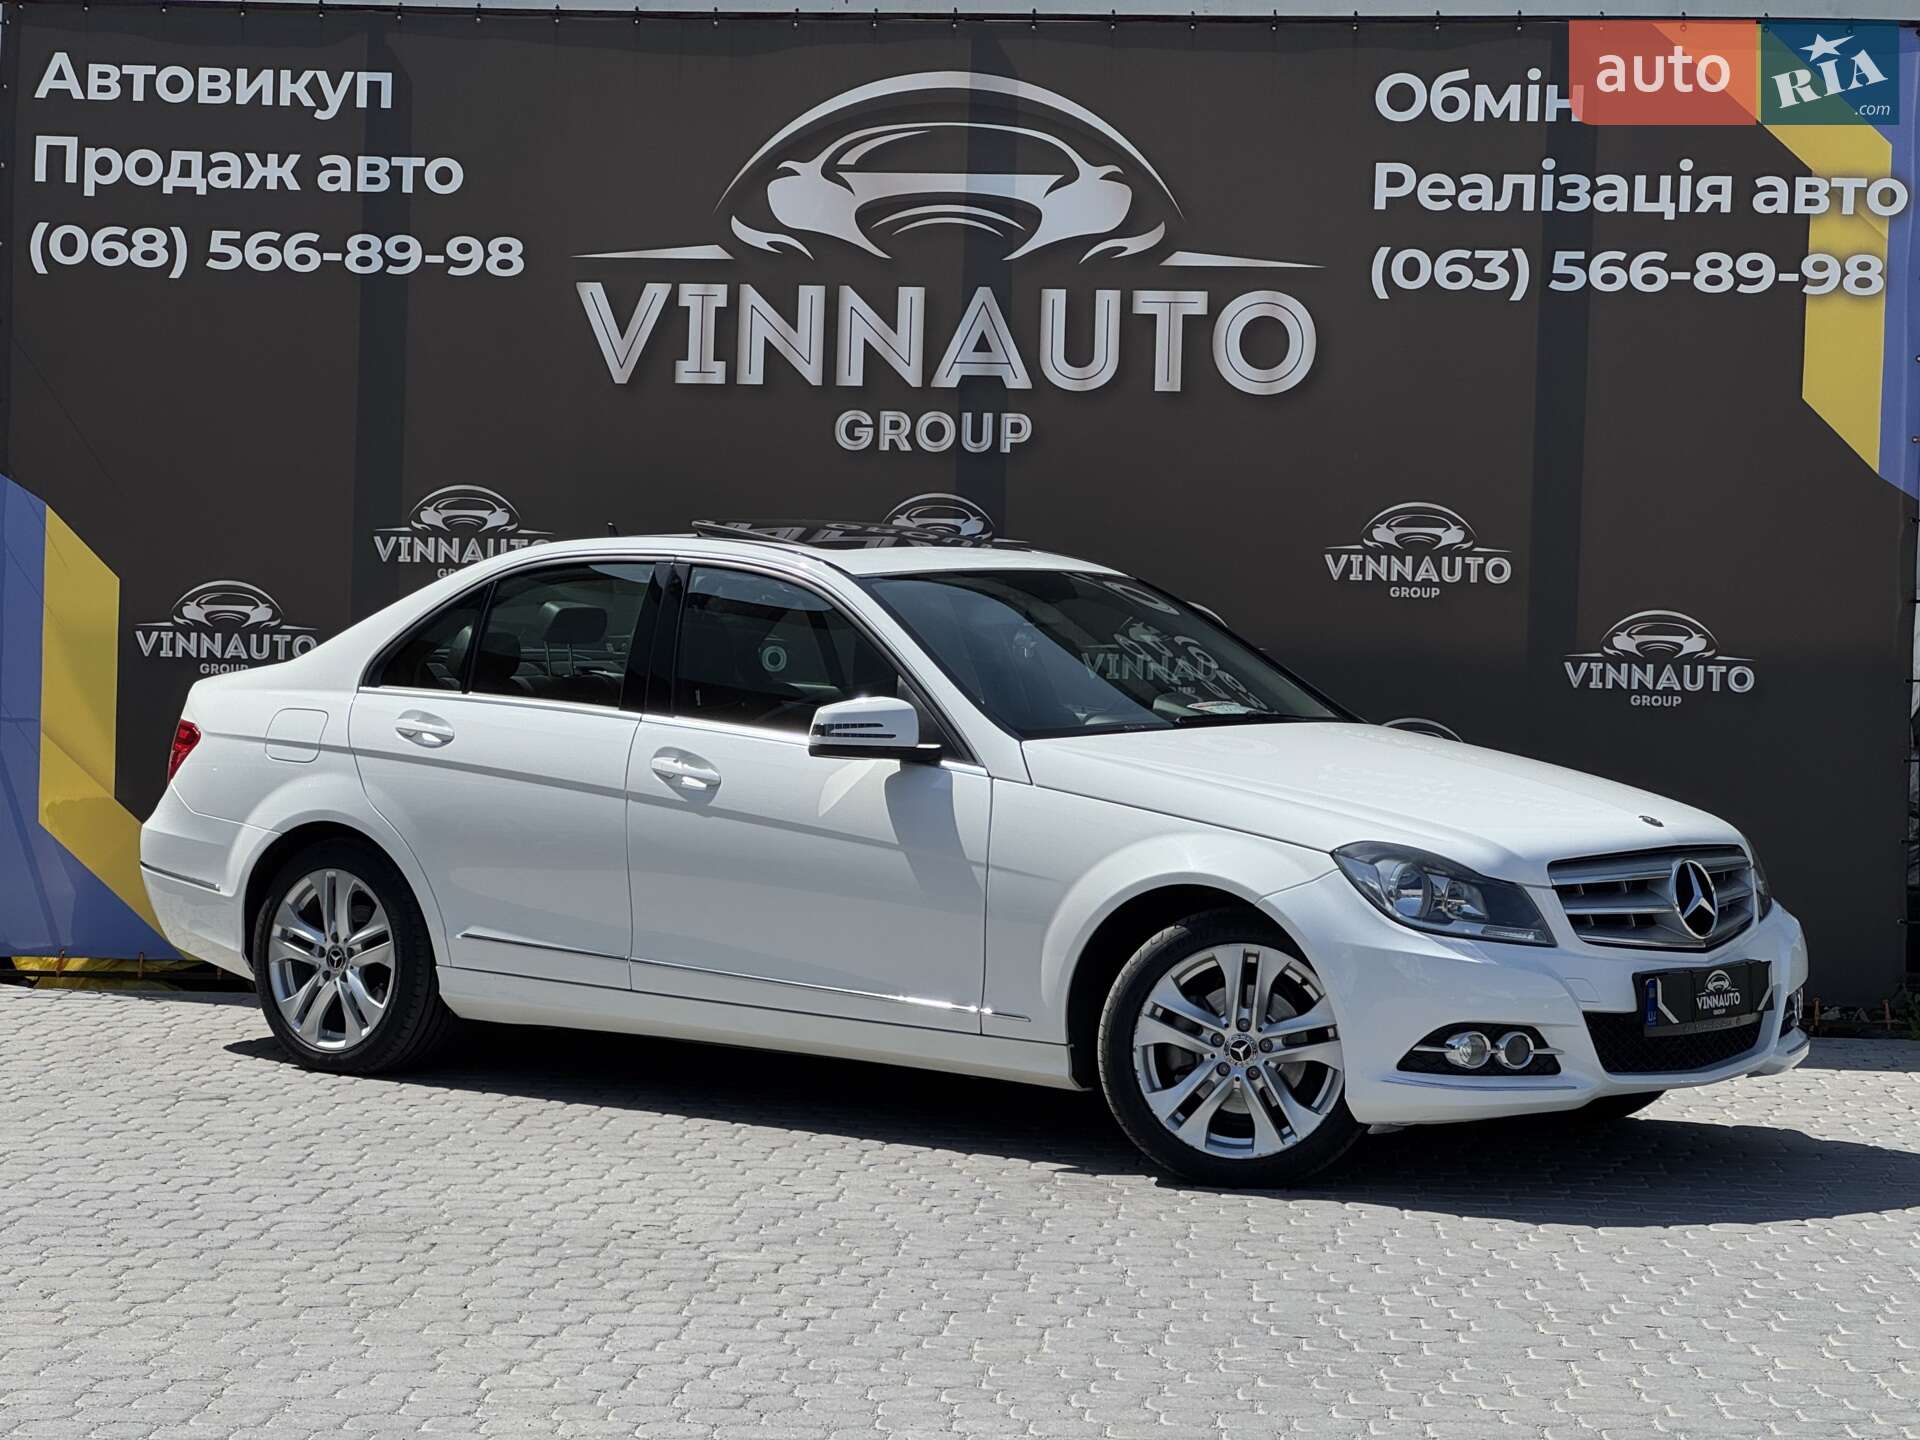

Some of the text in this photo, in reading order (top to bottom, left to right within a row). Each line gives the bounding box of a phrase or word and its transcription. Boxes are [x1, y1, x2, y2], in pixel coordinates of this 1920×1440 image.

[33, 52, 393, 121] Автовикуп
[1374, 67, 1585, 123] Обмін
[33, 135, 465, 197] Продаж авто
[1372, 157, 1909, 221] Реалізація авто
[29, 222, 526, 279] (068) 566-89-98
[1370, 245, 1885, 301] (063) 566-89-98
[575, 281, 1317, 396] VINNAUTO
[834, 409, 1033, 454] GROUP
[1324, 553, 1512, 585] VINNAUTO
[1389, 586, 1441, 598] GROUP
[135, 630, 318, 661] VINNAUTO
[1564, 661, 1755, 694] VINNAUTO
[1630, 694, 1682, 707] GROUP
[1696, 992, 1741, 1010] VINNAUTO
